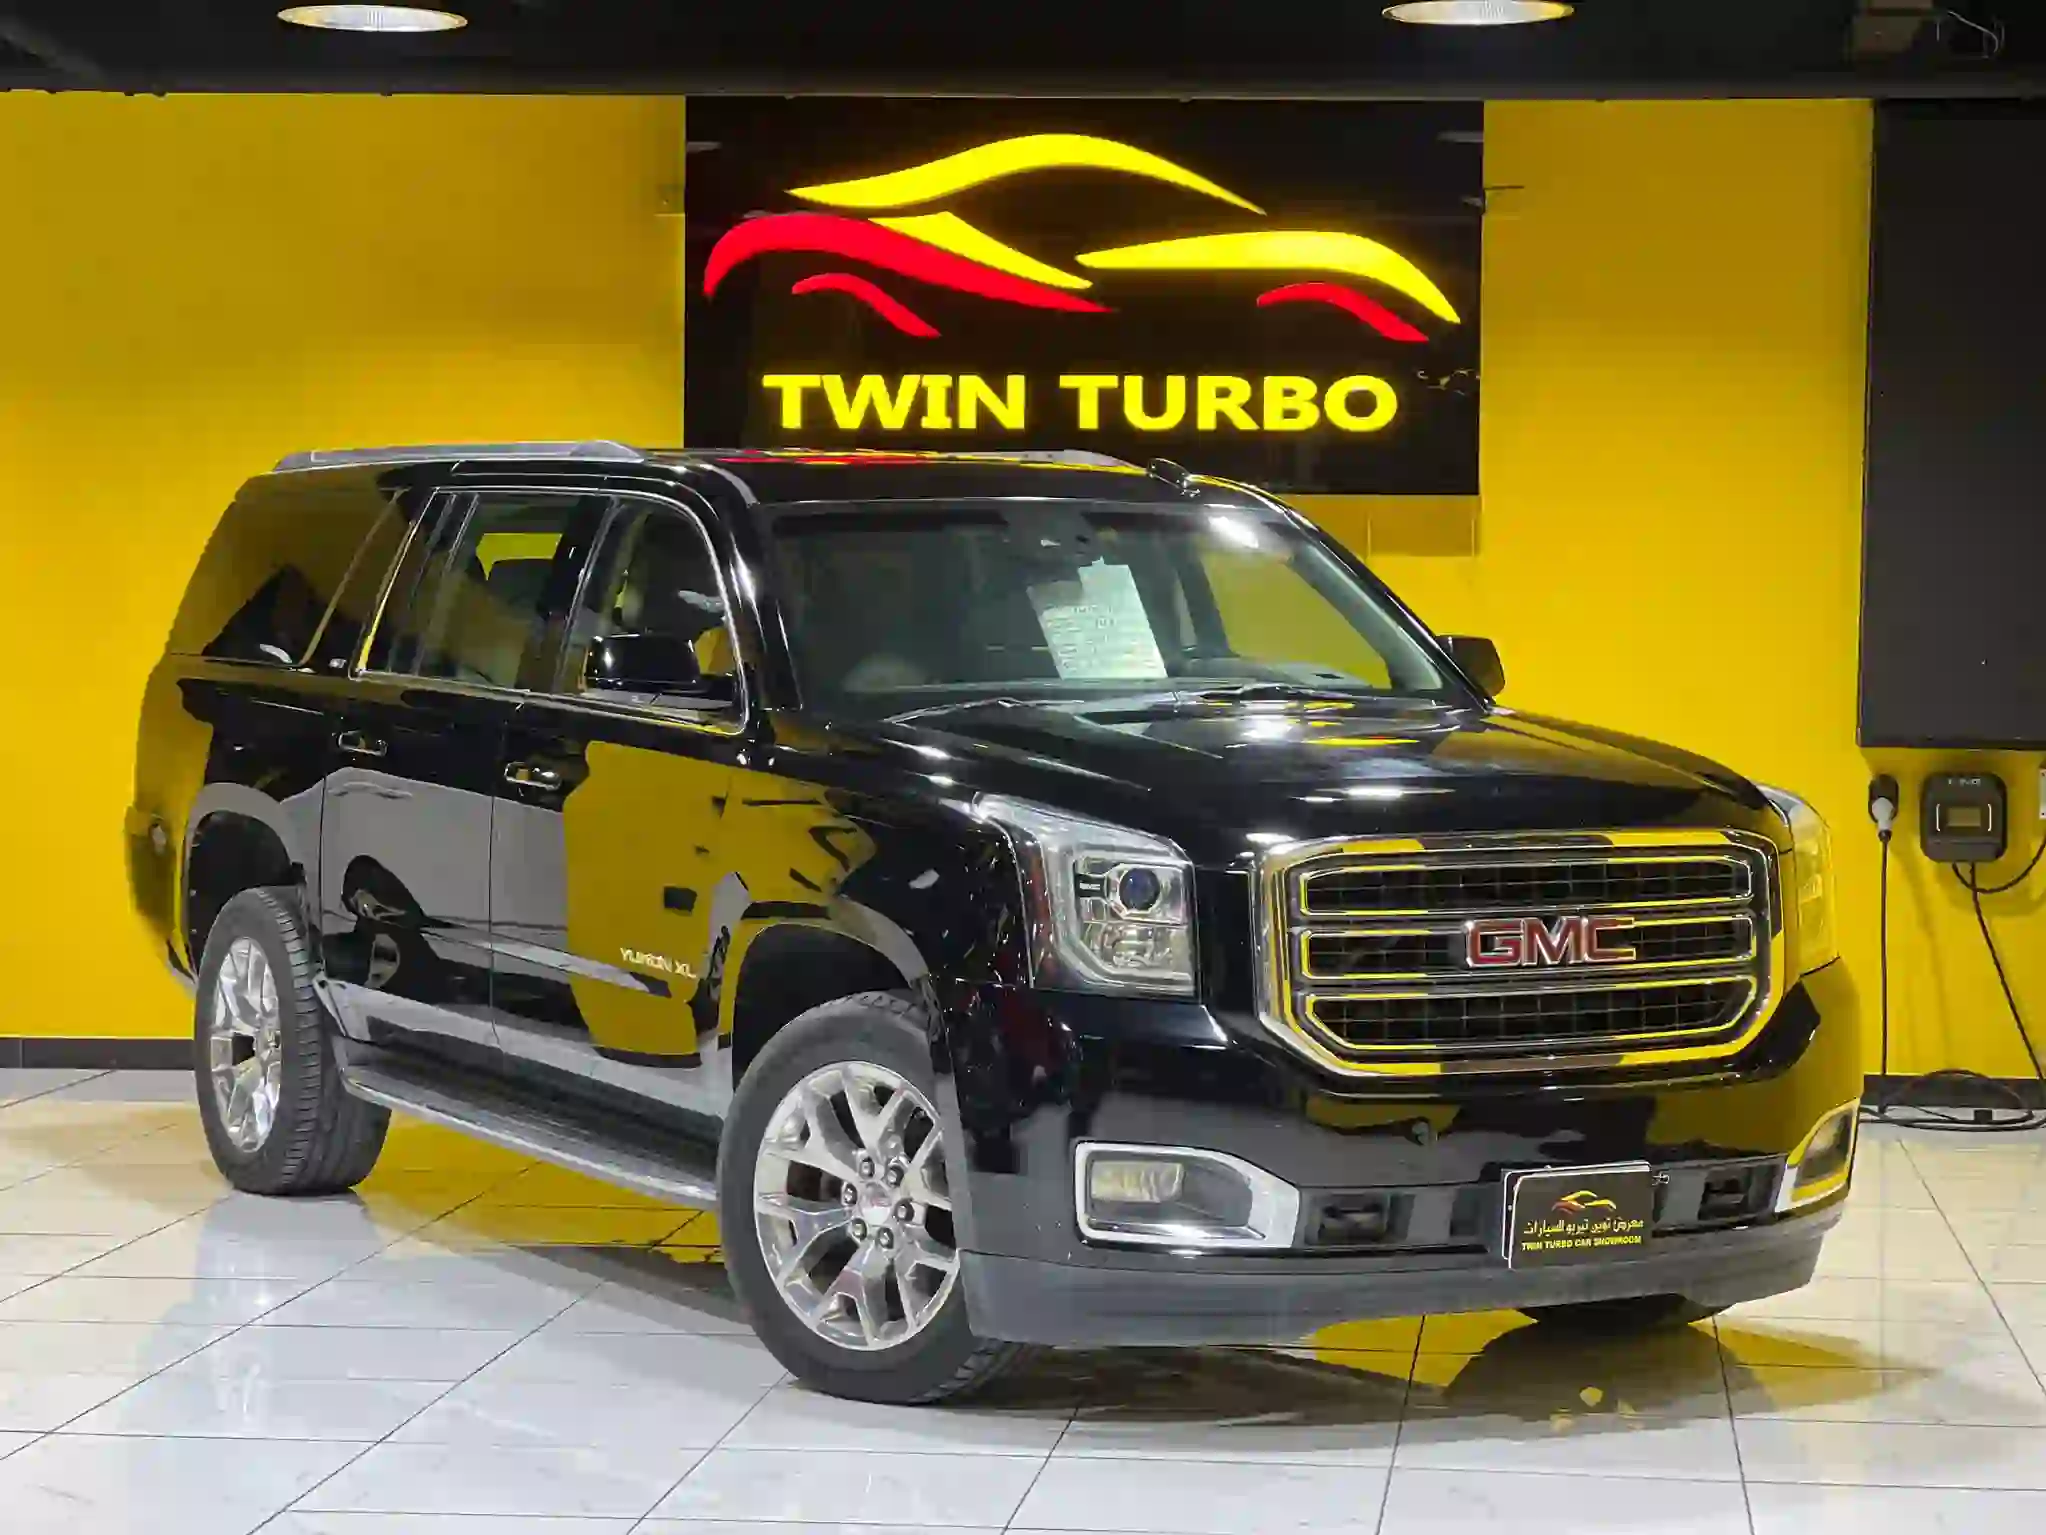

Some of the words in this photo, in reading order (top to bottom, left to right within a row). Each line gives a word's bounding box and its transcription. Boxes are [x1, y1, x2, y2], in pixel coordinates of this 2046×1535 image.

[763, 374, 1026, 430] TWIN
[1059, 374, 1398, 432] TURBO
[1466, 915, 1637, 967] GMC
[675, 960, 697, 979] XL
[1613, 1216, 1644, 1233] معرض
[1545, 1239, 1573, 1249] TURBO
[1575, 1238, 1592, 1248] CAR
